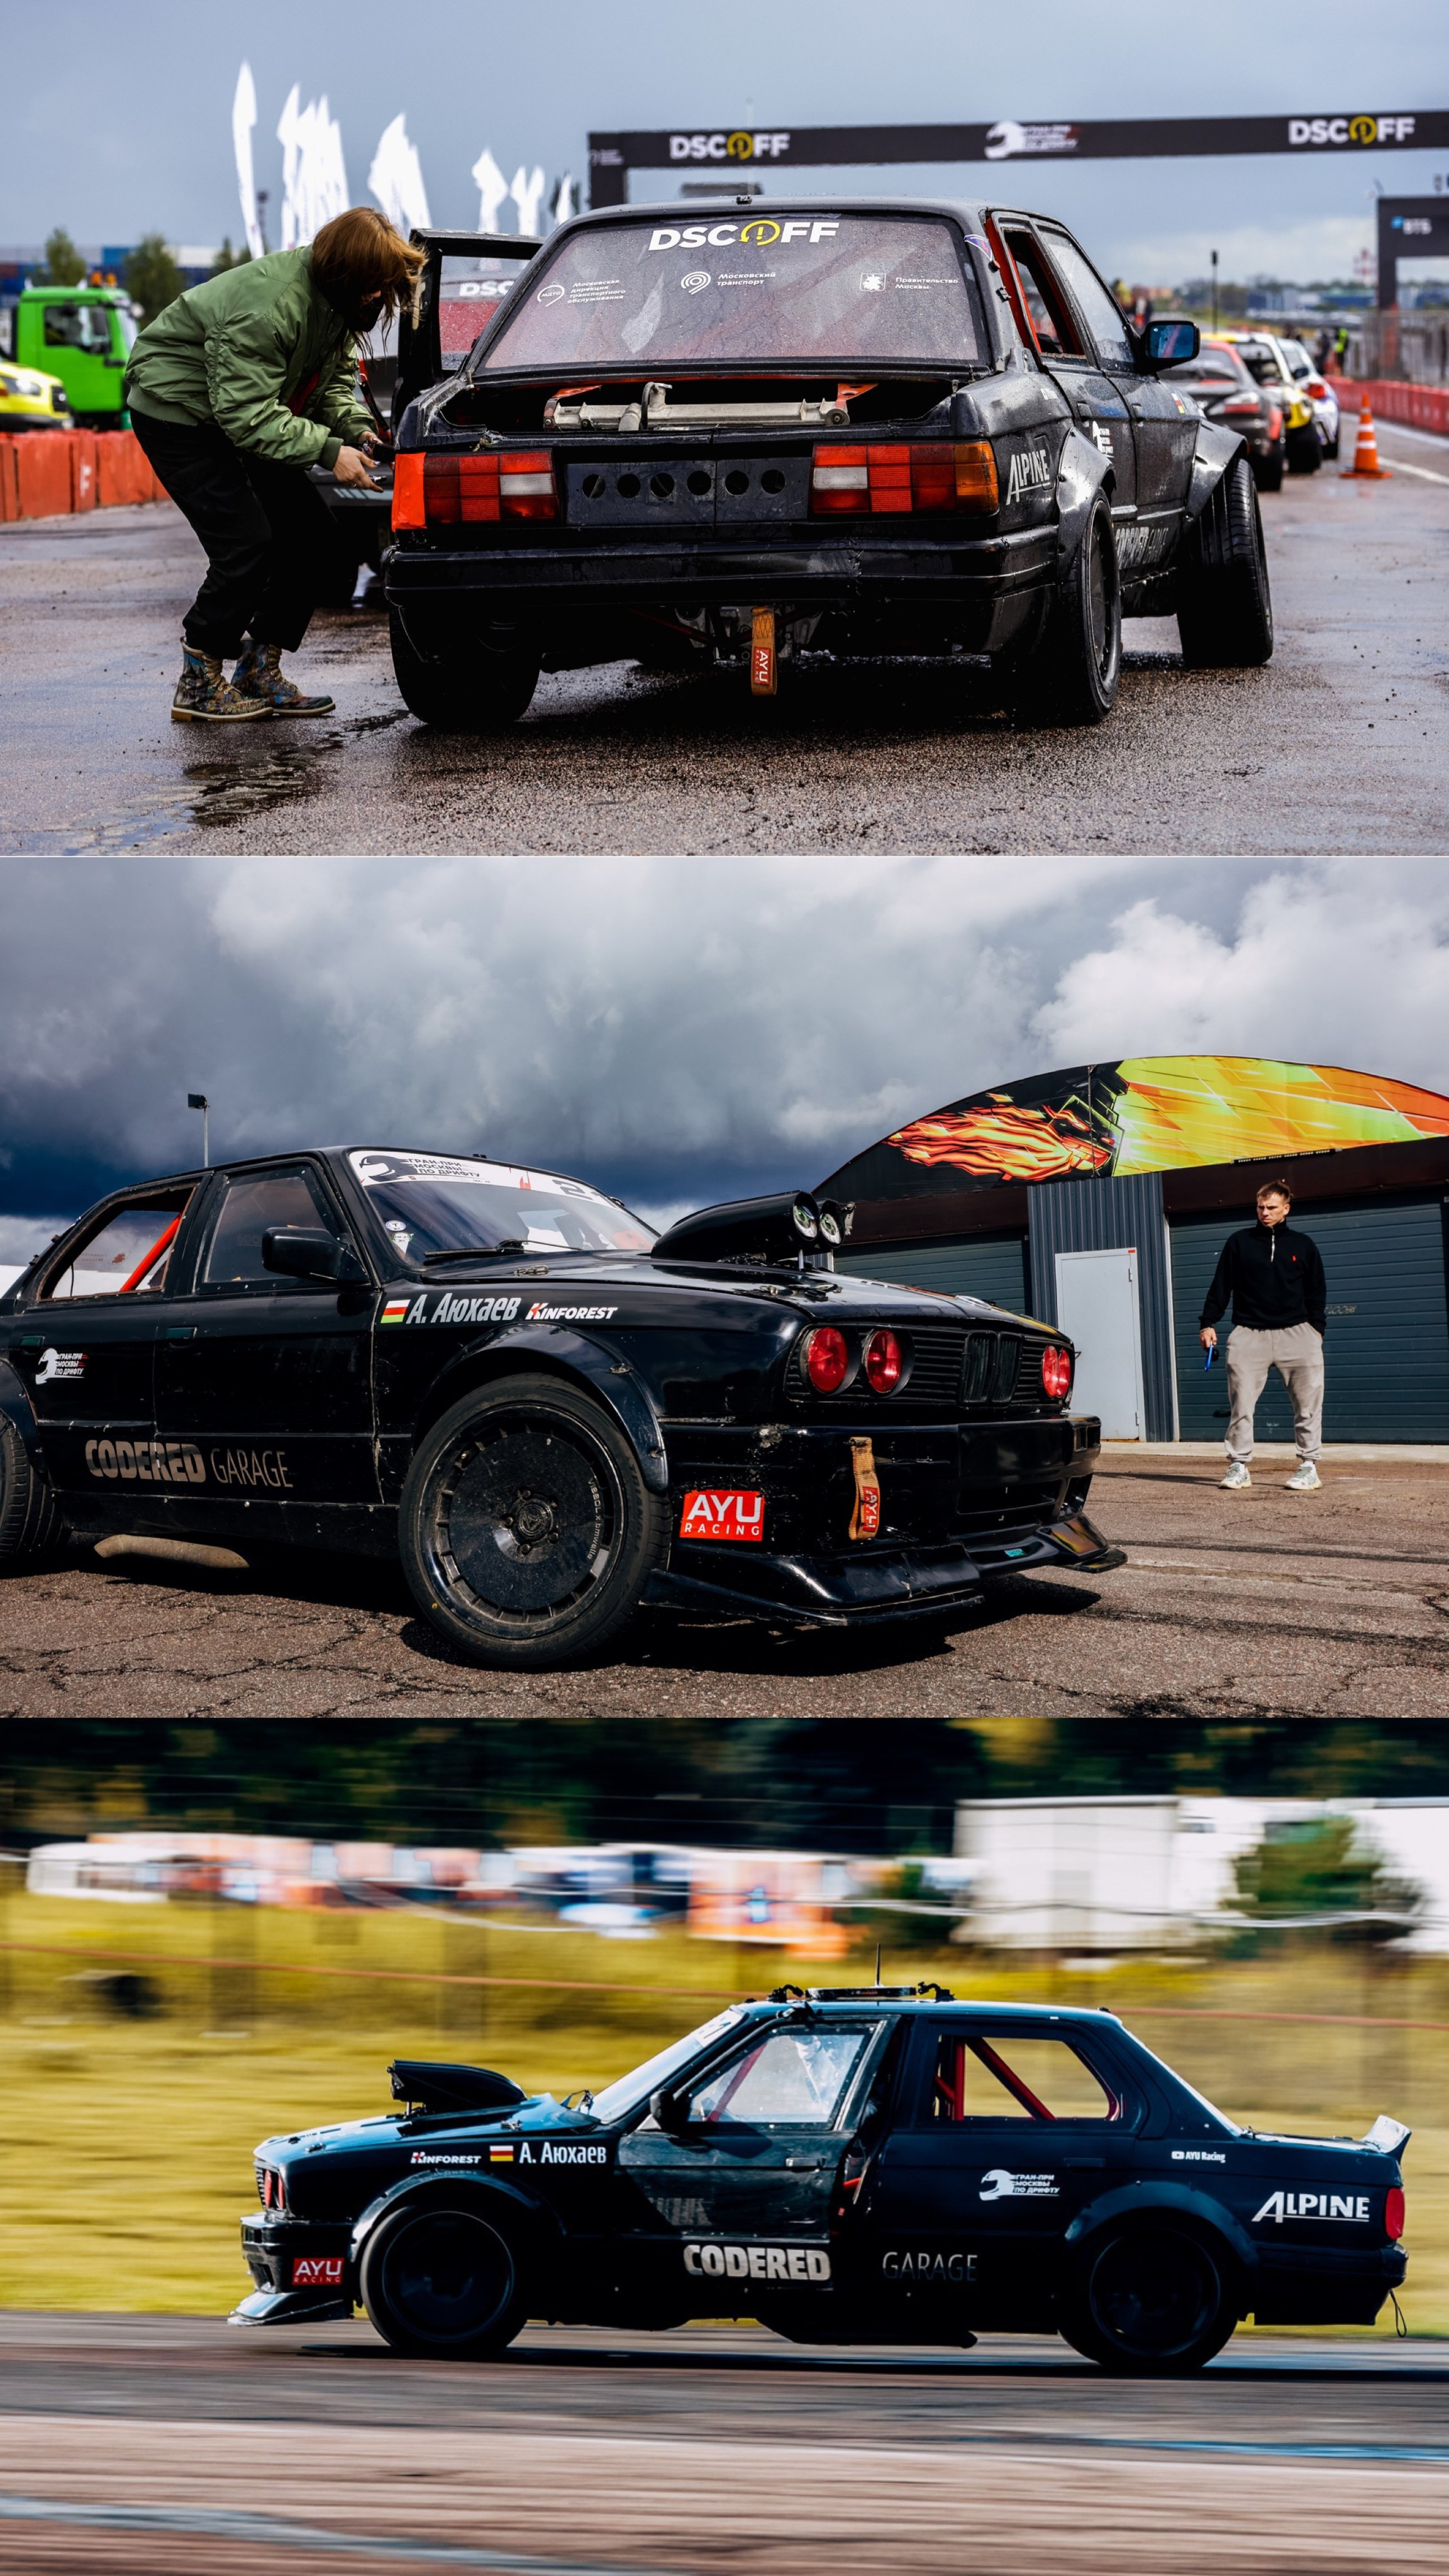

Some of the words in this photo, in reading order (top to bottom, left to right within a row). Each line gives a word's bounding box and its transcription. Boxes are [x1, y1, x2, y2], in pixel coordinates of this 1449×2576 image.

[717, 279, 765, 287] транспорт
[567, 295, 624, 304] обслуживания
[569, 290, 626, 299] транспортного
[1006, 449, 1051, 506] ALPINE
[760, 650, 769, 682] AYU
[406, 1294, 428, 1324] А.
[431, 1292, 522, 1324] Аюхаев
[525, 1302, 619, 1321] KINFOREST
[85, 1439, 206, 1484] CODERED
[210, 1448, 293, 1488] GARAGE
[686, 1494, 762, 1523] AYU
[684, 1522, 760, 1536] RACING
[410, 2151, 482, 2164] KINFOREST
[519, 2142, 536, 2164] А.
[541, 2141, 607, 2164] Аюхаев
[1185, 2151, 1200, 2160] AYU
[1201, 2151, 1226, 2163] Racing
[1251, 2191, 1370, 2223] ALPINE
[295, 2260, 342, 2276] AYU
[684, 2245, 831, 2281] CODERED
[882, 2251, 979, 2281] GARAGE
